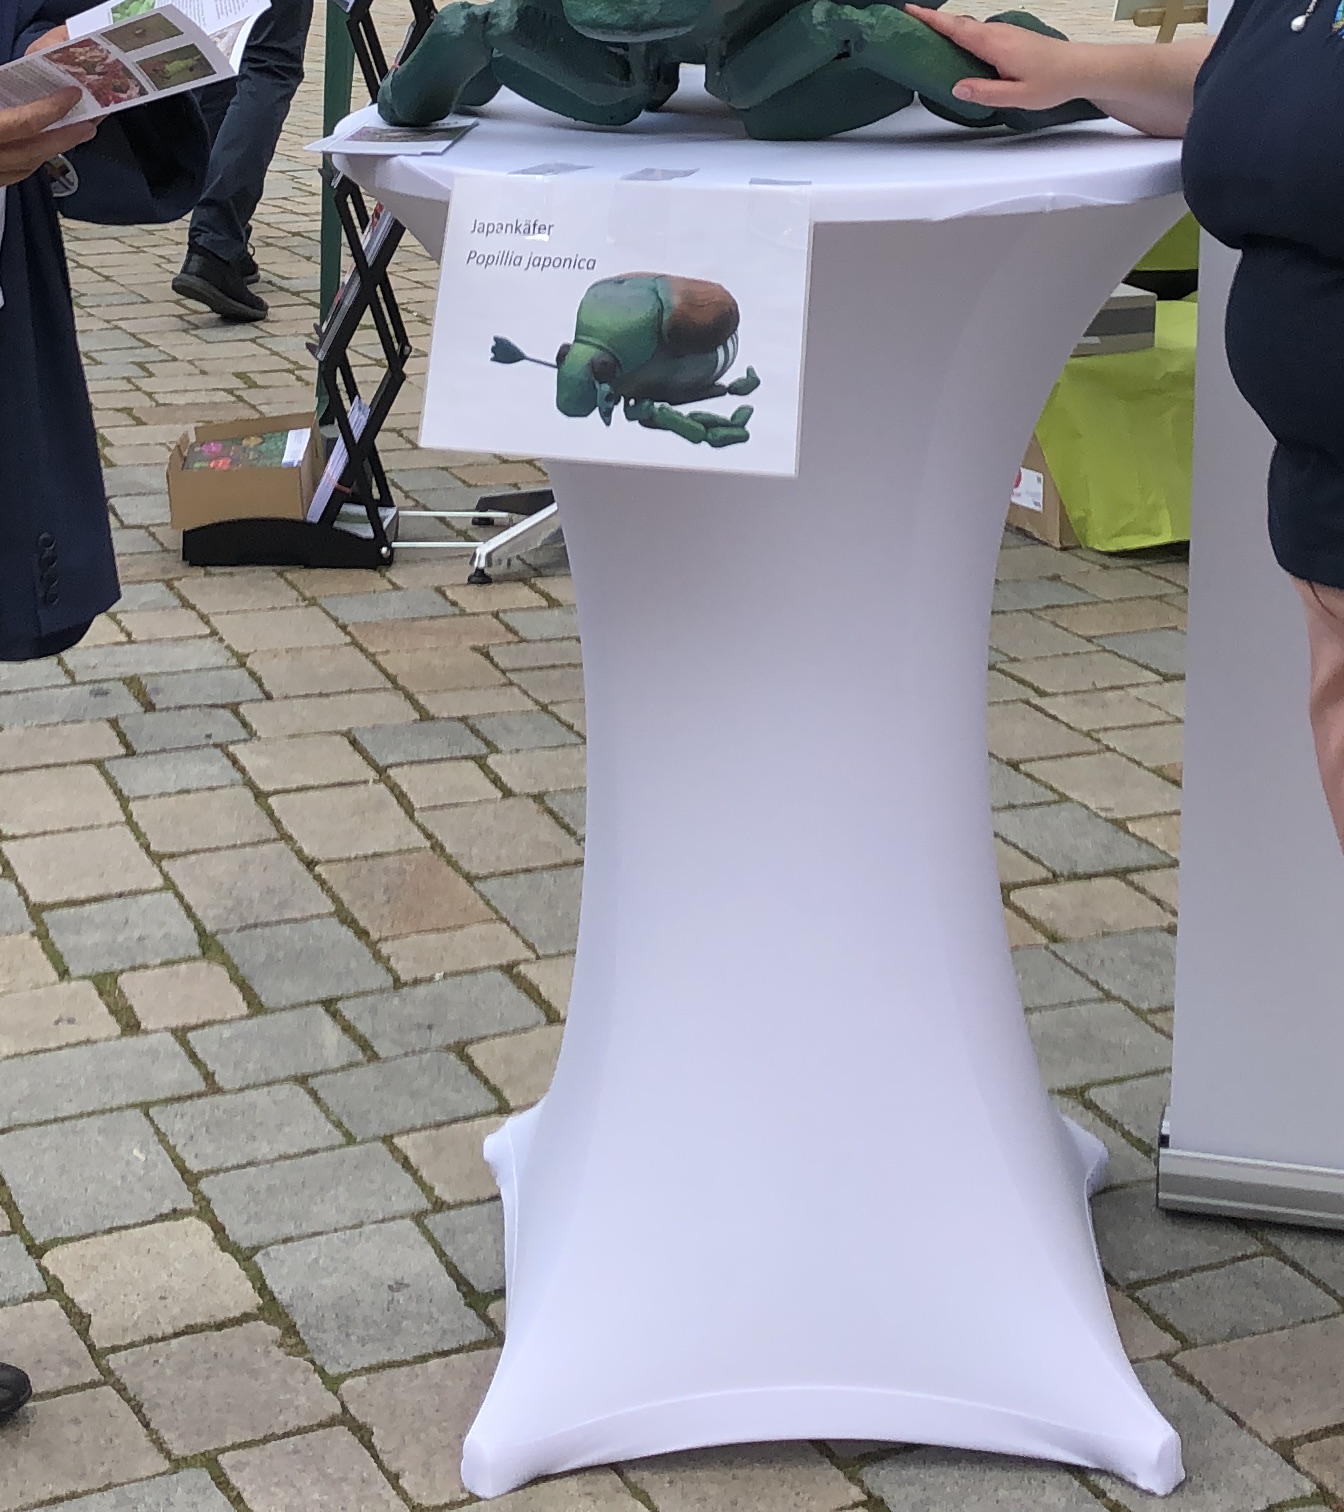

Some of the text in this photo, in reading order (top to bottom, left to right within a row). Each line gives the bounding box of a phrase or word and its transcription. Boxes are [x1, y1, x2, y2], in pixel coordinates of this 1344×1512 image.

[470, 219, 554, 237] Japankäfer
[466, 250, 597, 271] Popillia japonica
